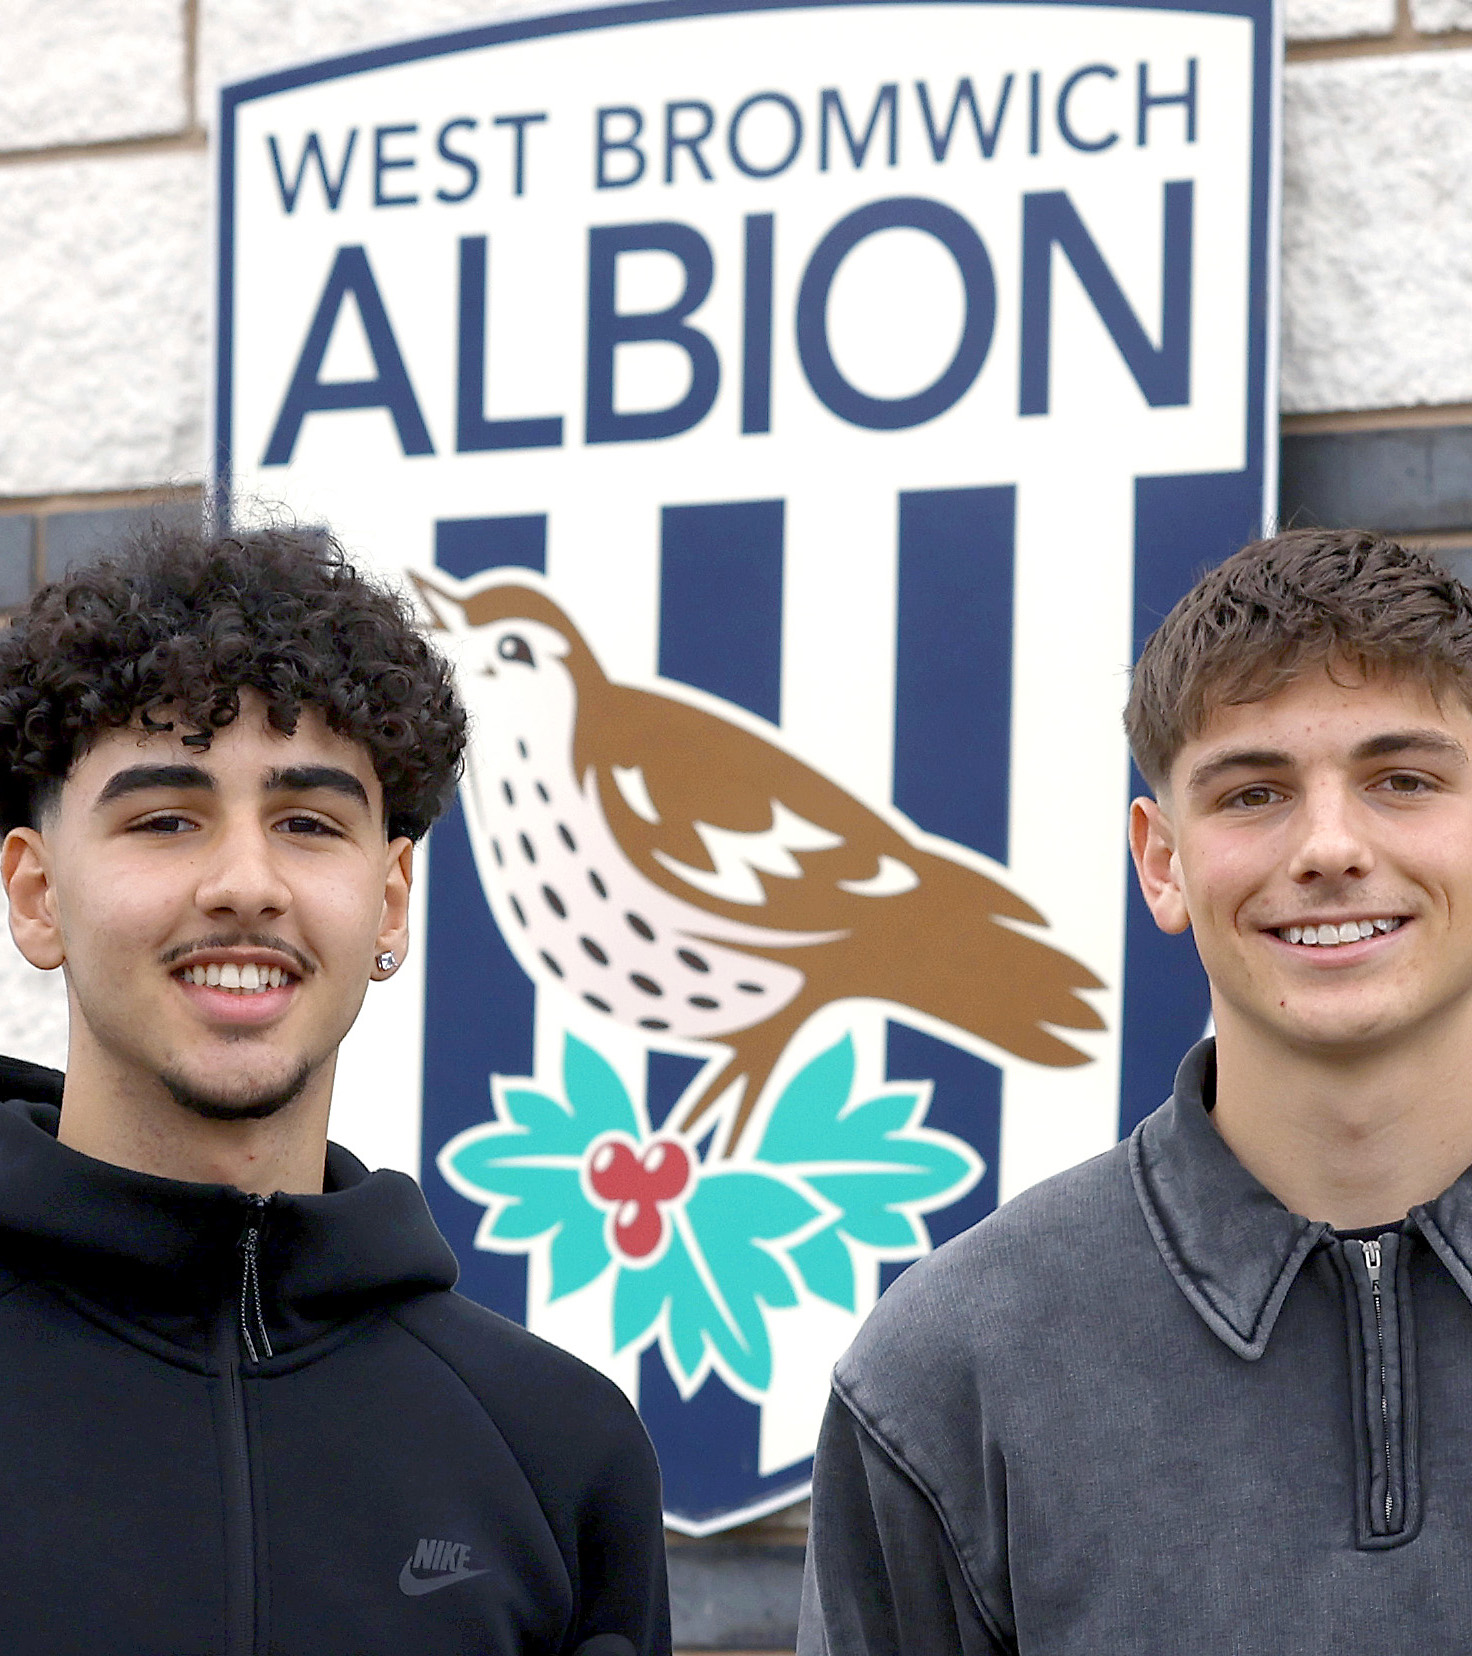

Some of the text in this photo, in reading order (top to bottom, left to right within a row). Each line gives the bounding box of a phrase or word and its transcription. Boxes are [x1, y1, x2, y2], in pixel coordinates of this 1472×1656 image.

[267, 57, 1200, 215] WEST BROMWICH
[260, 180, 1195, 467] ALBION
[412, 1538, 472, 1573] NIKE
